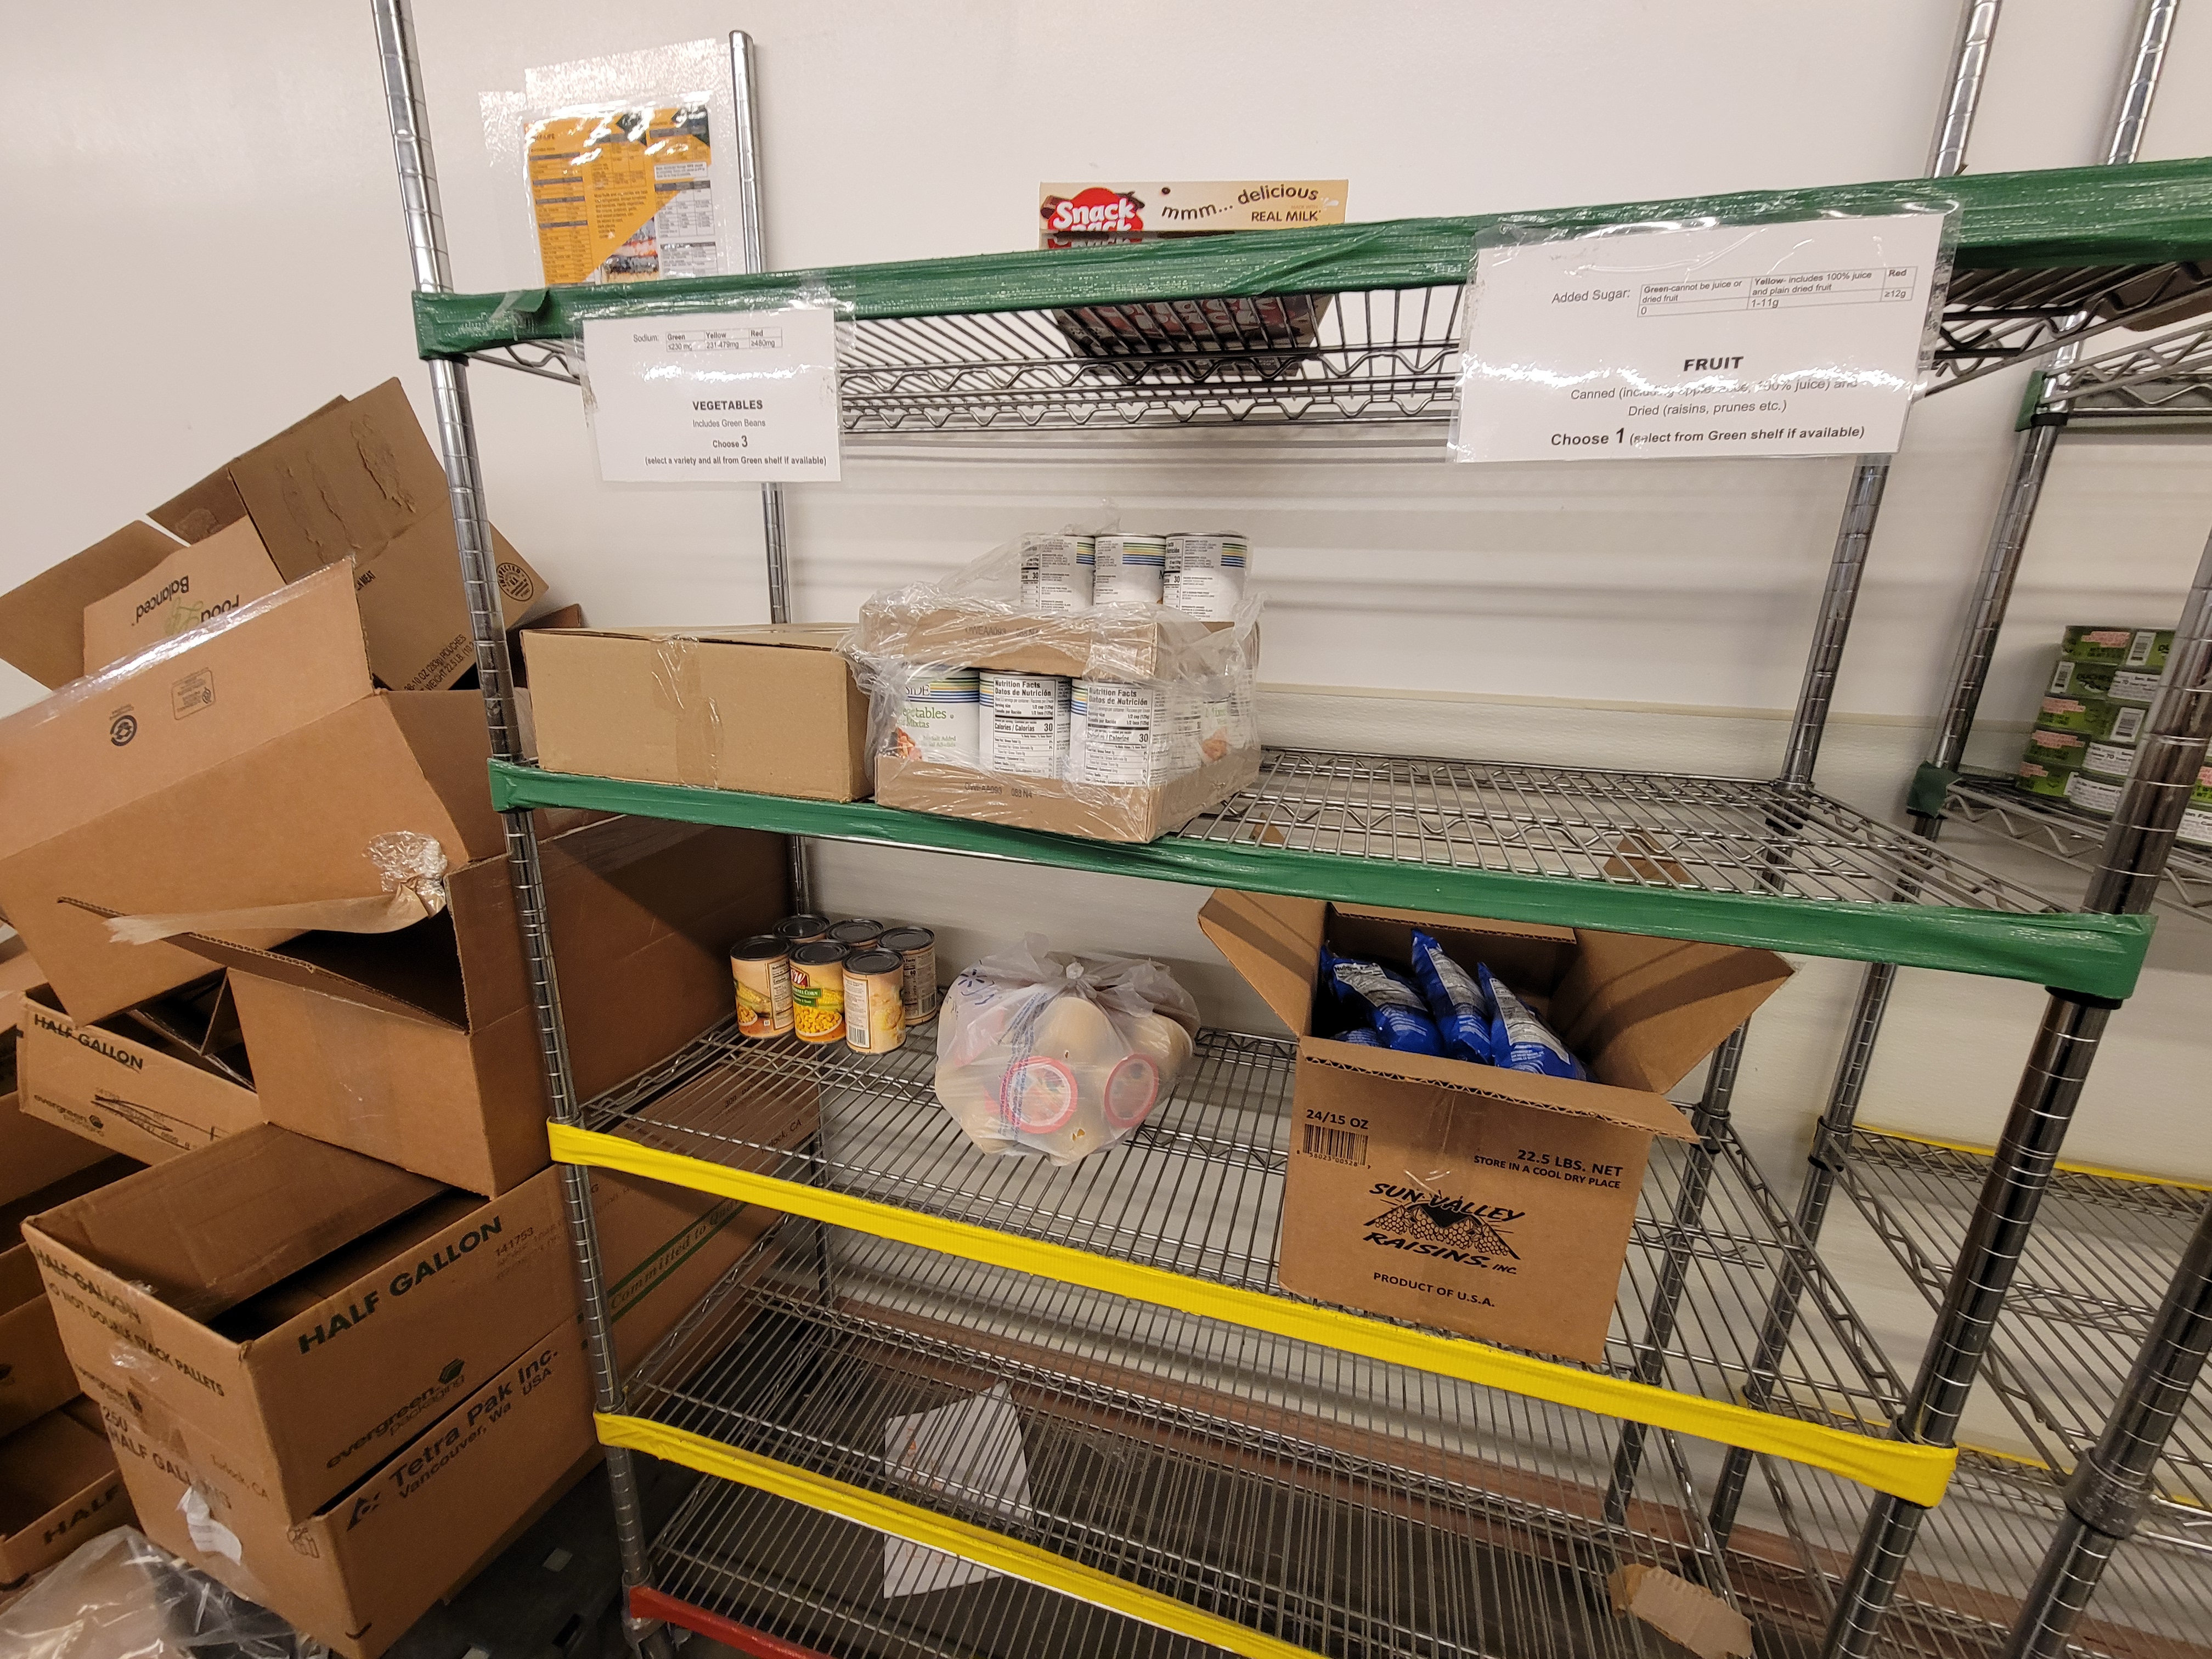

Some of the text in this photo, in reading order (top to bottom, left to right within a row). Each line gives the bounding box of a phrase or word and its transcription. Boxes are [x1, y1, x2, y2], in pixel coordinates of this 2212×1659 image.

[1053, 198, 1135, 229] Snack
[1238, 184, 1319, 205] delicious
[1251, 211, 1282, 222] REAL
[1644, 284, 1698, 294] Green-cannot
[1711, 281, 1731, 291] juice
[1754, 278, 1786, 286] Yellow-
[1826, 272, 1850, 281] 100%
[1850, 271, 1872, 281] juice
[1551, 289, 1630, 304] Added Sugar:
[1643, 295, 1662, 303] dried
[1769, 286, 1790, 297] plain
[1792, 285, 1813, 293] dried
[1815, 283, 1832, 291] fruit
[1640, 306, 1647, 315] 0
[1751, 298, 1779, 308] 1-11g
[633, 334, 659, 342] Sodium:
[1683, 356, 1744, 371] FRUIT
[1571, 388, 1616, 400] Canned
[1794, 379, 1830, 392] juice)
[692, 400, 763, 410] VEGETABLES
[1628, 400, 1787, 417] Dried (raisins, prunes etc.)
[692, 419, 765, 427] Includes Green Beans
[741, 435, 748, 447] 3
[1551, 426, 1865, 445] Choose 1 (select from Green shelf if available)
[645, 456, 667, 466] (select
[673, 456, 696, 466] variety
[791, 456, 826, 466] available)
[362, 570, 376, 587] MEAT
[498, 565, 521, 587] INSPECTED
[136, 575, 189, 624] Balanced
[419, 634, 467, 680] OZ POUCHES
[424, 669, 447, 691] WEIGHT
[444, 659, 458, 673] 22.5
[995, 680, 1020, 688] Nutrition
[1044, 723, 1053, 731] 30
[1139, 733, 1148, 742] 30
[34, 1014, 143, 1070] HALF GALLON
[790, 1119, 802, 1132] CA
[1307, 1109, 1369, 1129] 24/15 OZ
[1310, 1152, 1331, 1161] 58023
[1335, 1158, 1357, 1167] 00528
[1517, 1149, 1623, 1177] 22.5 LBS. NET
[1474, 1155, 1621, 1189] STORE IN A COOL DRY PLACE
[1369, 1183, 1526, 1222] SUN VALLEY
[494, 1226, 534, 1256] 141753
[611, 1235, 690, 1309] Committed
[298, 1290, 380, 1355] HALF
[390, 1216, 503, 1297] GALLON
[1373, 1272, 1495, 1307] PRODUCT OF U.S.A.
[74, 1271, 141, 1324] GALLON
[134, 1334, 173, 1367] STACK
[175, 1358, 225, 1397] PALLETS
[326, 1386, 438, 1470] evergreen
[388, 1349, 558, 1488] Tetra Pak Inc.
[398, 1368, 552, 1499] Vancouver, Wa USA
[110, 1429, 147, 1459] HALF
[251, 1482, 269, 1501] CA
[44, 1483, 119, 1545] HALF
